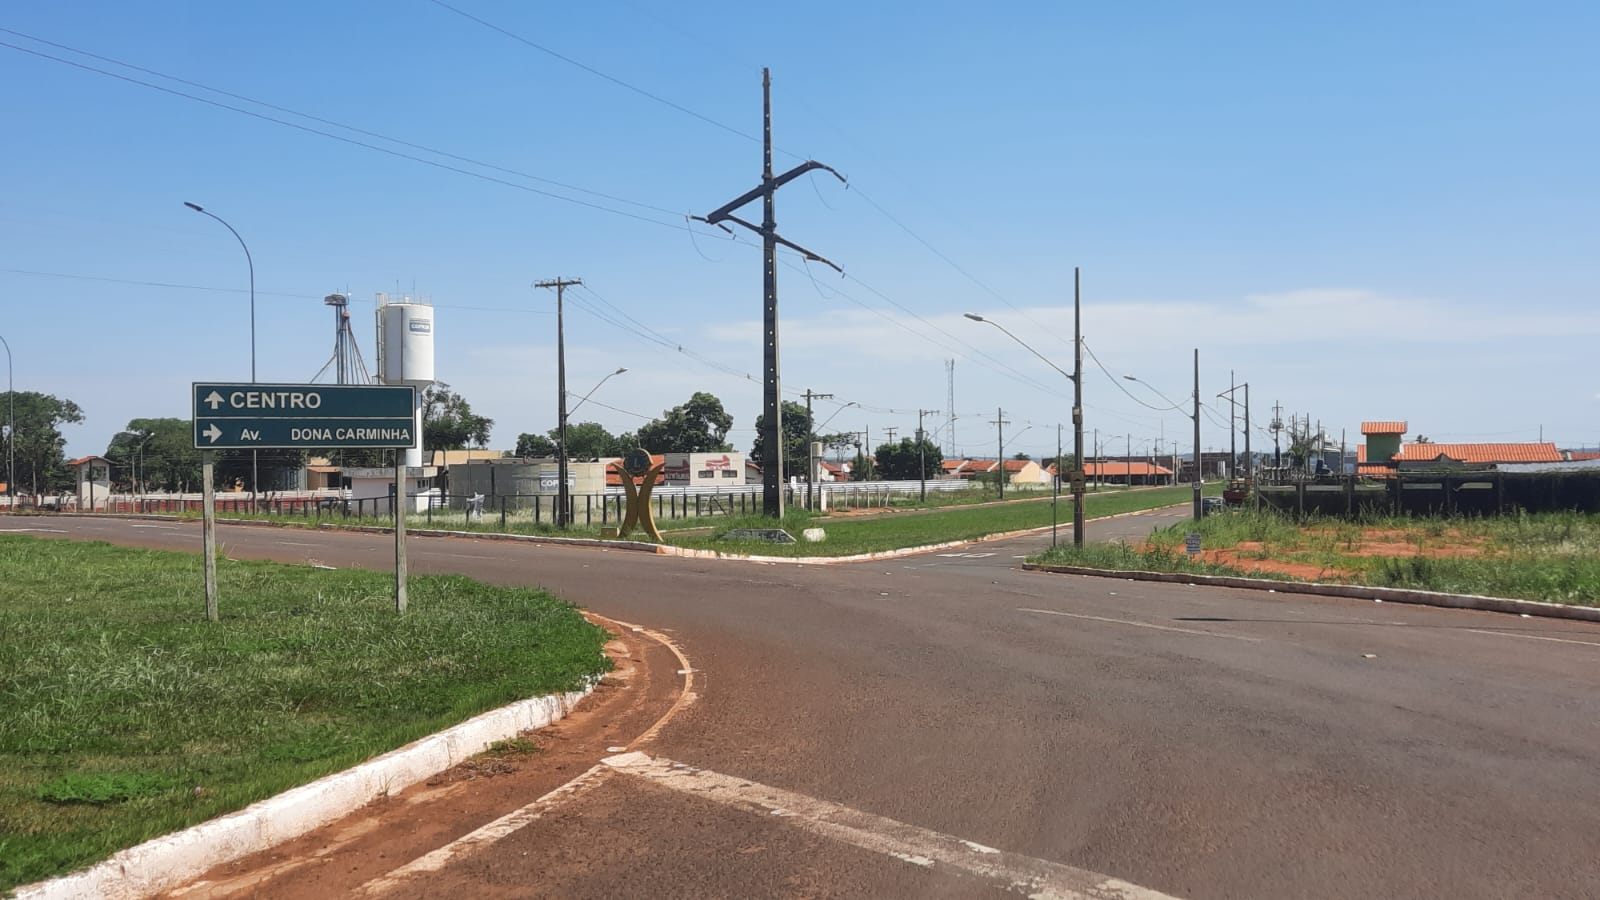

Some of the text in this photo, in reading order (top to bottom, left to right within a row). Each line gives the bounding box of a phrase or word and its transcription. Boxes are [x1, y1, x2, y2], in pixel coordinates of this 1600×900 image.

[230, 391, 322, 409] CENTRO
[291, 428, 332, 441] DONA
[335, 428, 410, 441] CARMINHA
